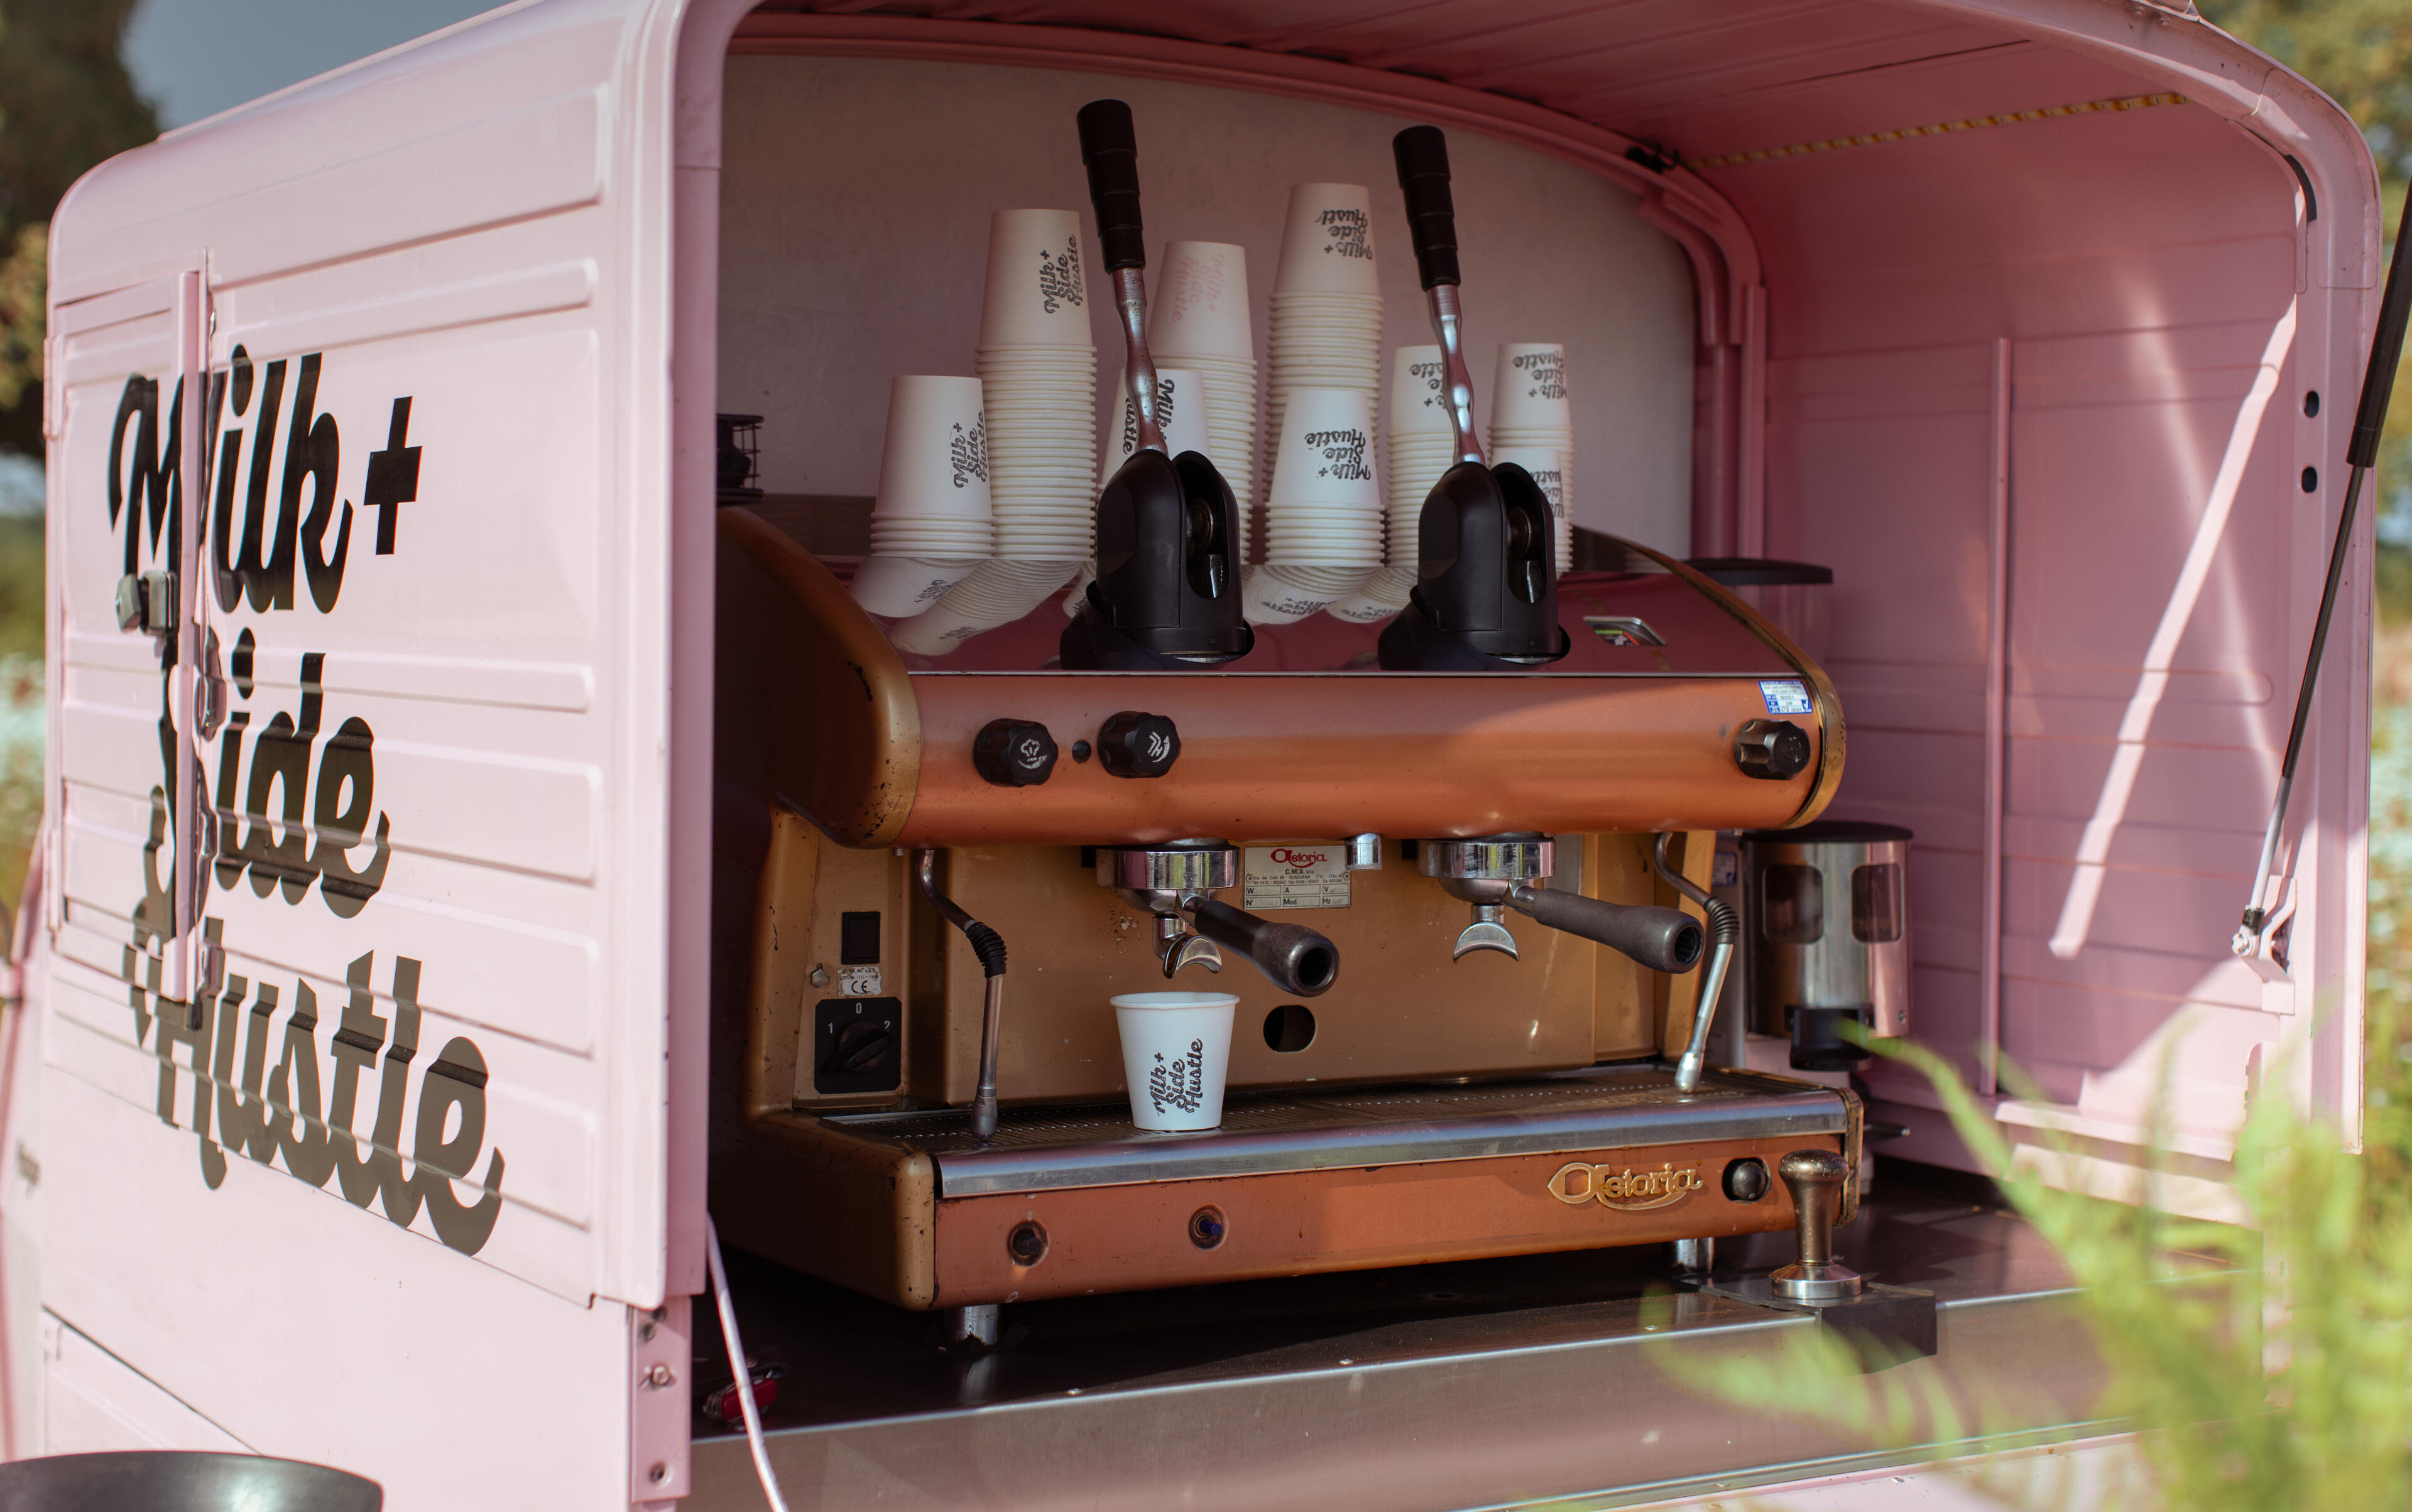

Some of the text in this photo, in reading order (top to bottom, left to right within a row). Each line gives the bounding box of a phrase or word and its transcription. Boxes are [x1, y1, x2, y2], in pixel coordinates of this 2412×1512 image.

[1327, 224, 1367, 243] Side
[1335, 242, 1373, 260] Milk
[1039, 261, 1060, 313] Milk
[1056, 253, 1075, 302] Side
[1067, 233, 1083, 307] Hustle
[1512, 352, 1564, 370] Hustle
[1123, 397, 1137, 455] ustle
[1304, 428, 1366, 448] Hustle
[951, 435, 969, 488] Milk
[967, 428, 981, 477] Side
[1322, 446, 1364, 465] Side
[1330, 464, 1371, 481] Milk
[107, 344, 354, 614] Milk
[1270, 849, 1328, 868] Astoria
[828, 1022, 834, 1034] 1
[856, 1003, 862, 1014] 0
[884, 1020, 890, 1031] 2
[122, 901, 506, 1257] Hustle
[1149, 1064, 1167, 1116] Milk
[1165, 1058, 1187, 1110] Side
[1184, 1038, 1203, 1113] Hustle
[1547, 1161, 1704, 1210] Astoria
